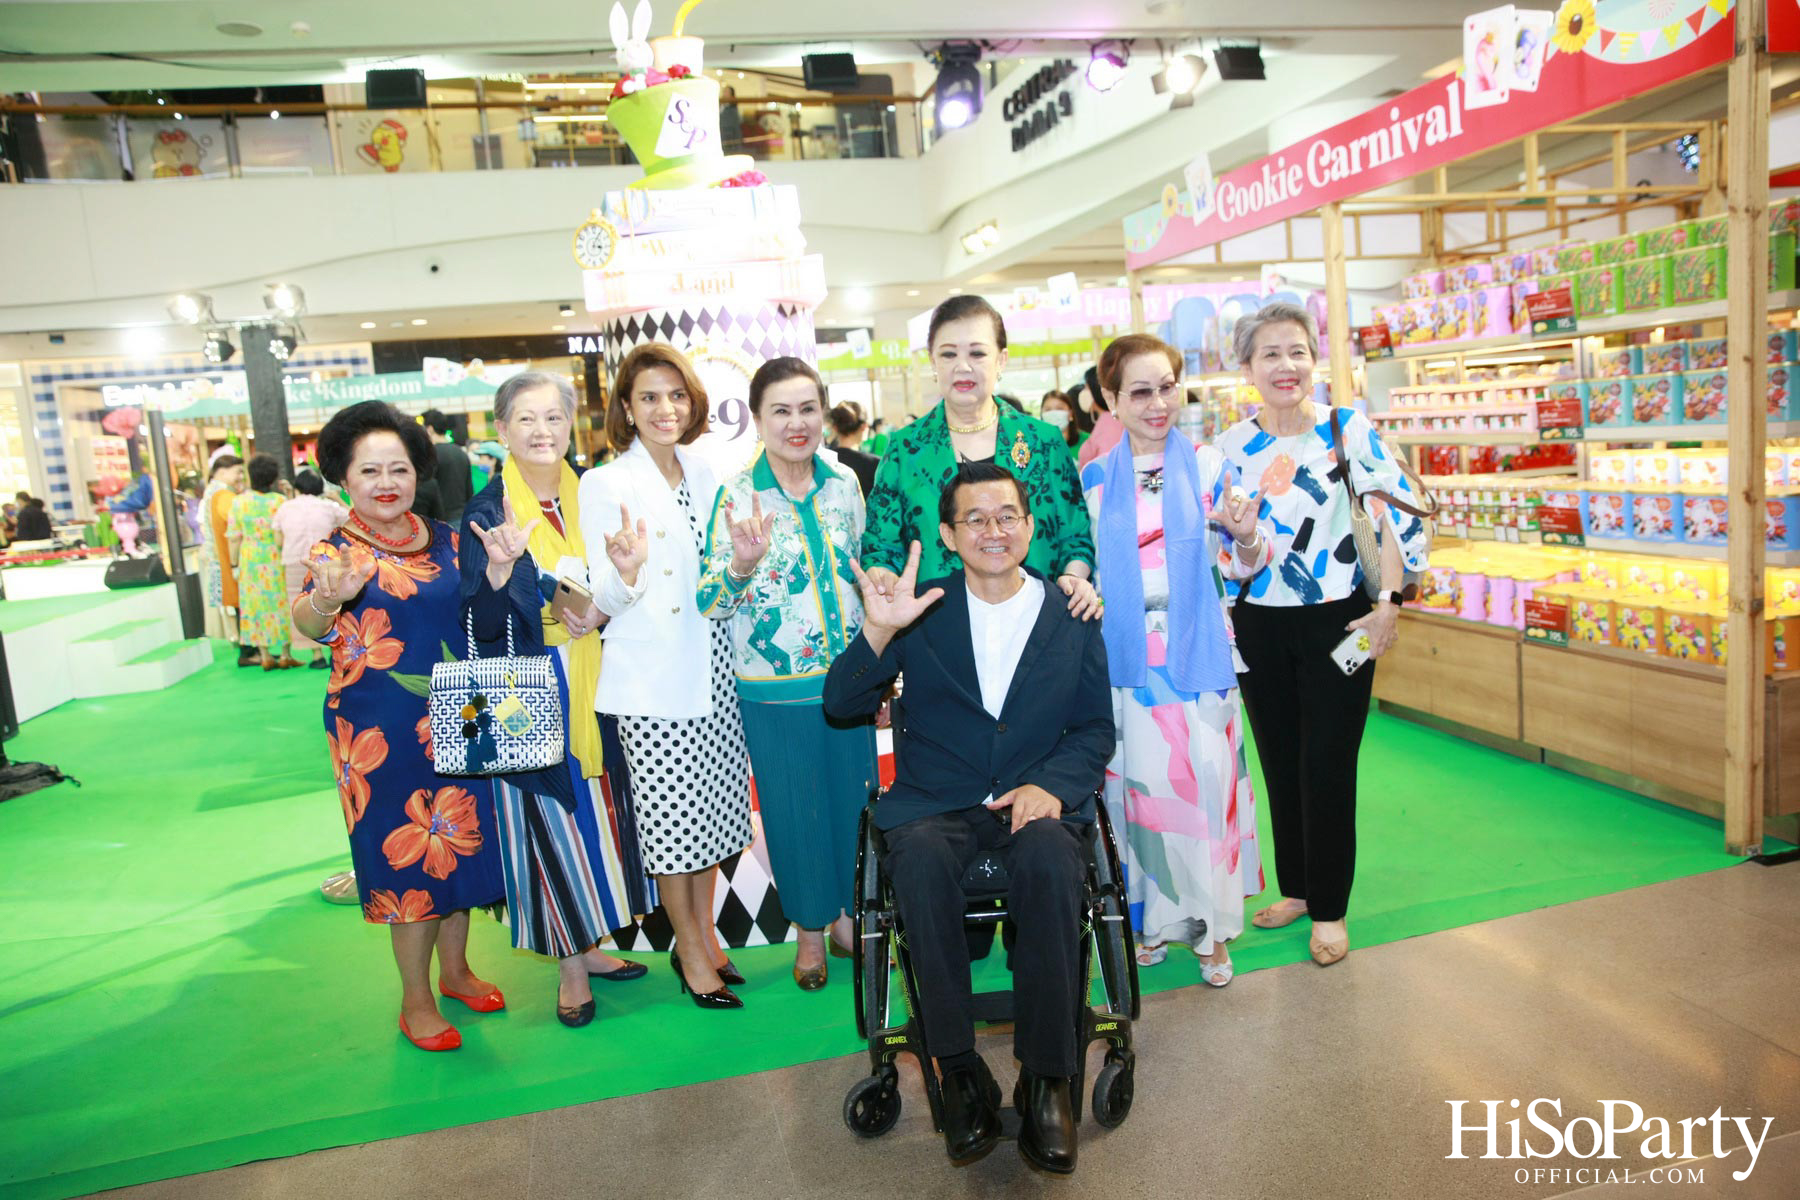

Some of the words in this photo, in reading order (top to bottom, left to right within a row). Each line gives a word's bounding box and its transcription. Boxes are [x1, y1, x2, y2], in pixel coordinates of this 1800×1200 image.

[1216, 155, 1304, 222] Cookie
[1306, 79, 1464, 188] Carnival
[1084, 292, 1162, 323] Hapy
[314, 378, 422, 402] Kingdom
